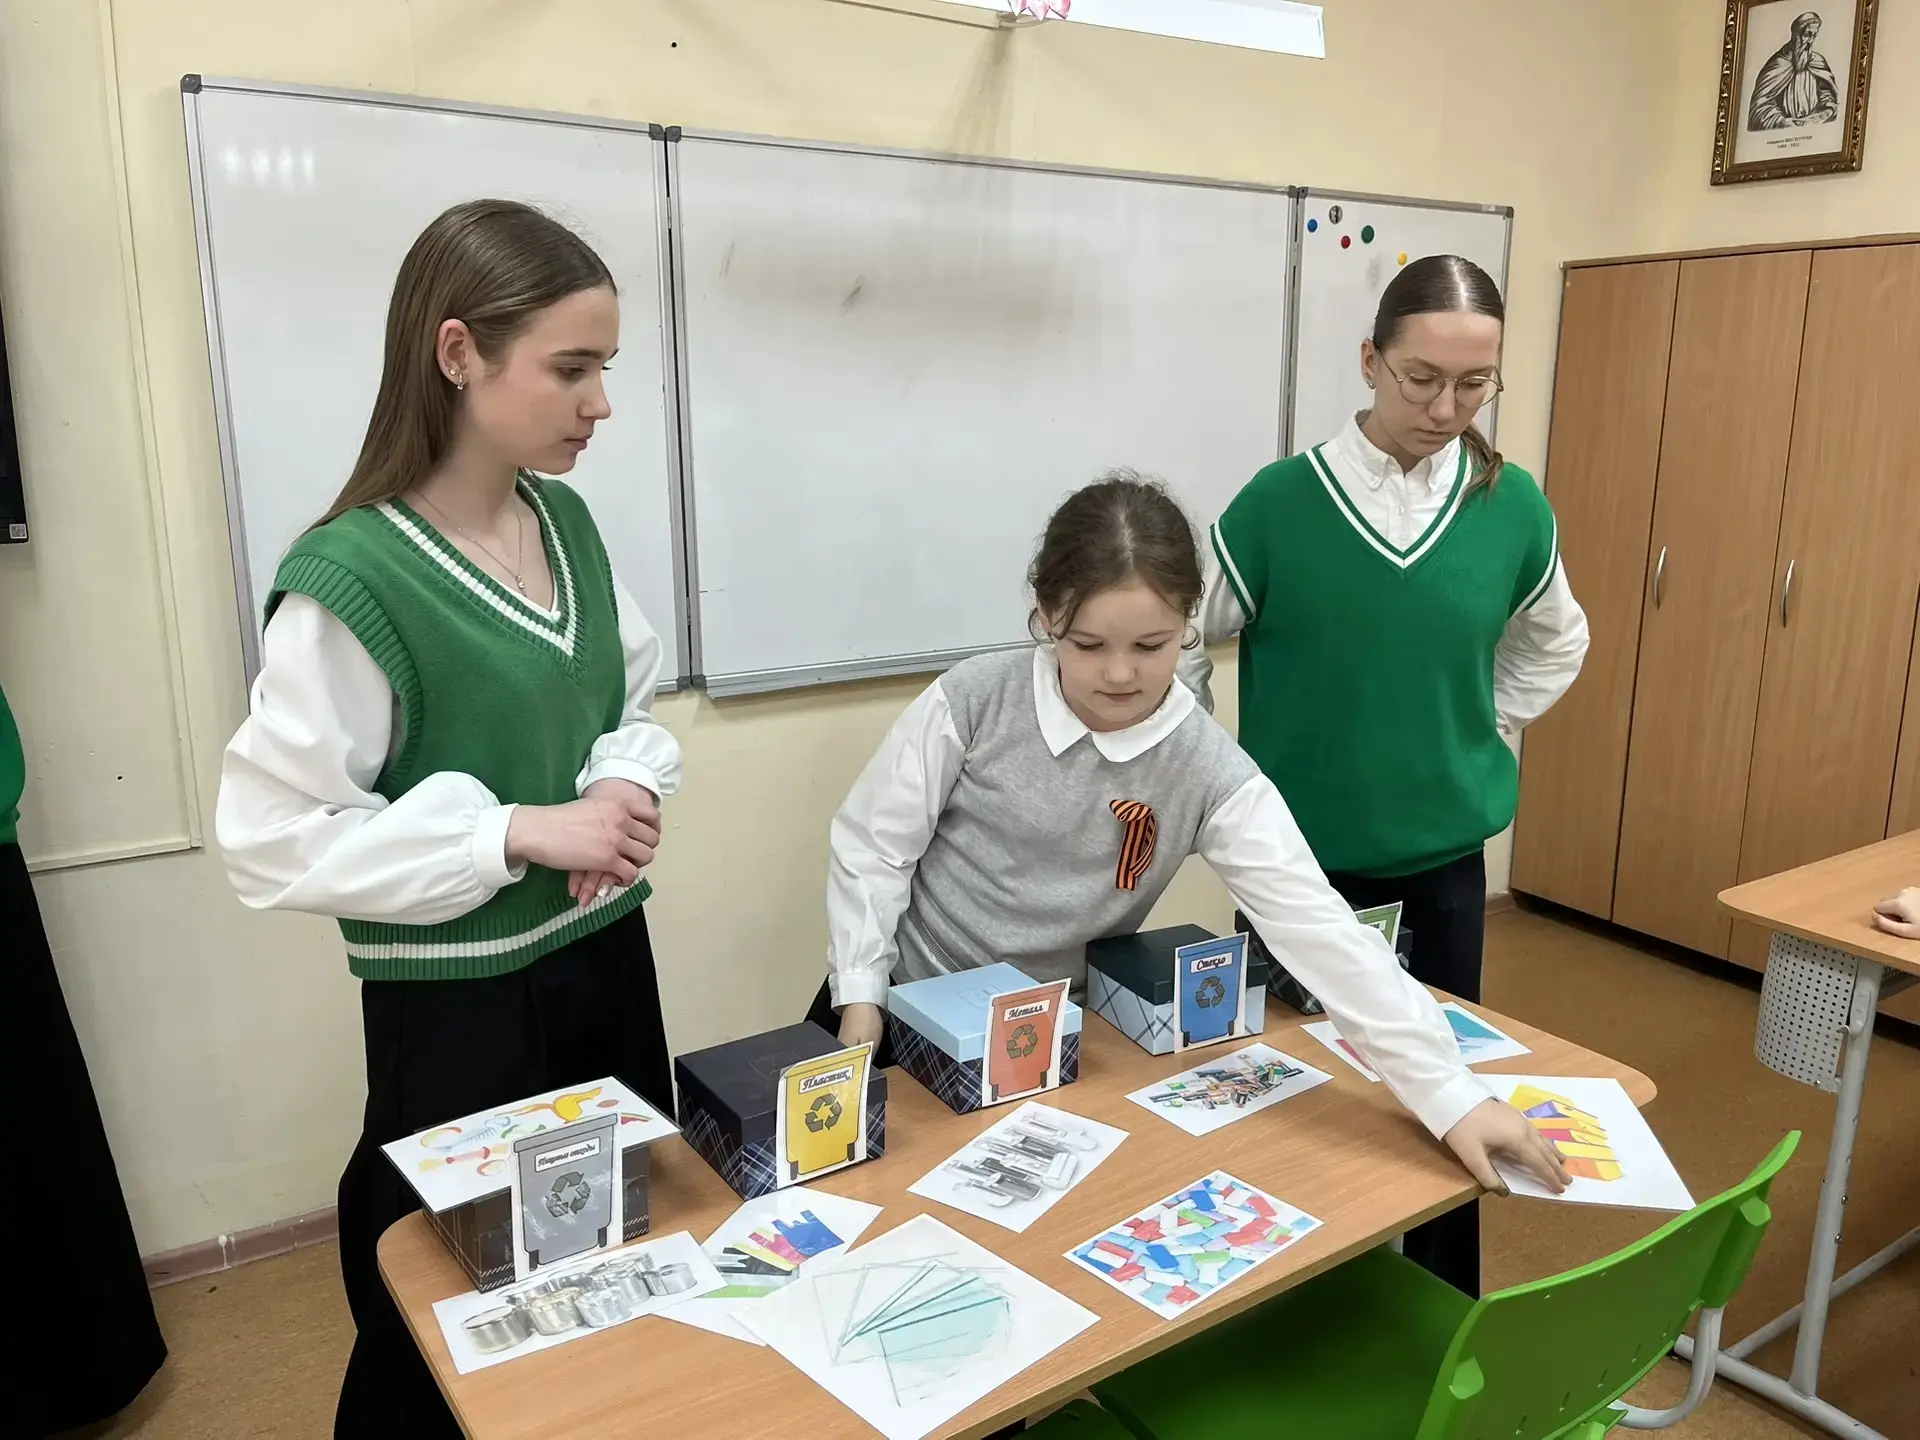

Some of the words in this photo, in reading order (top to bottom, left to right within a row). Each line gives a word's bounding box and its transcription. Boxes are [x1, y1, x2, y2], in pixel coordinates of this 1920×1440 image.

[1197, 956, 1226, 970] Стекло
[1007, 1004, 1043, 1019] Металл
[802, 1069, 850, 1090] Пластик
[570, 1143, 596, 1157] отходы
